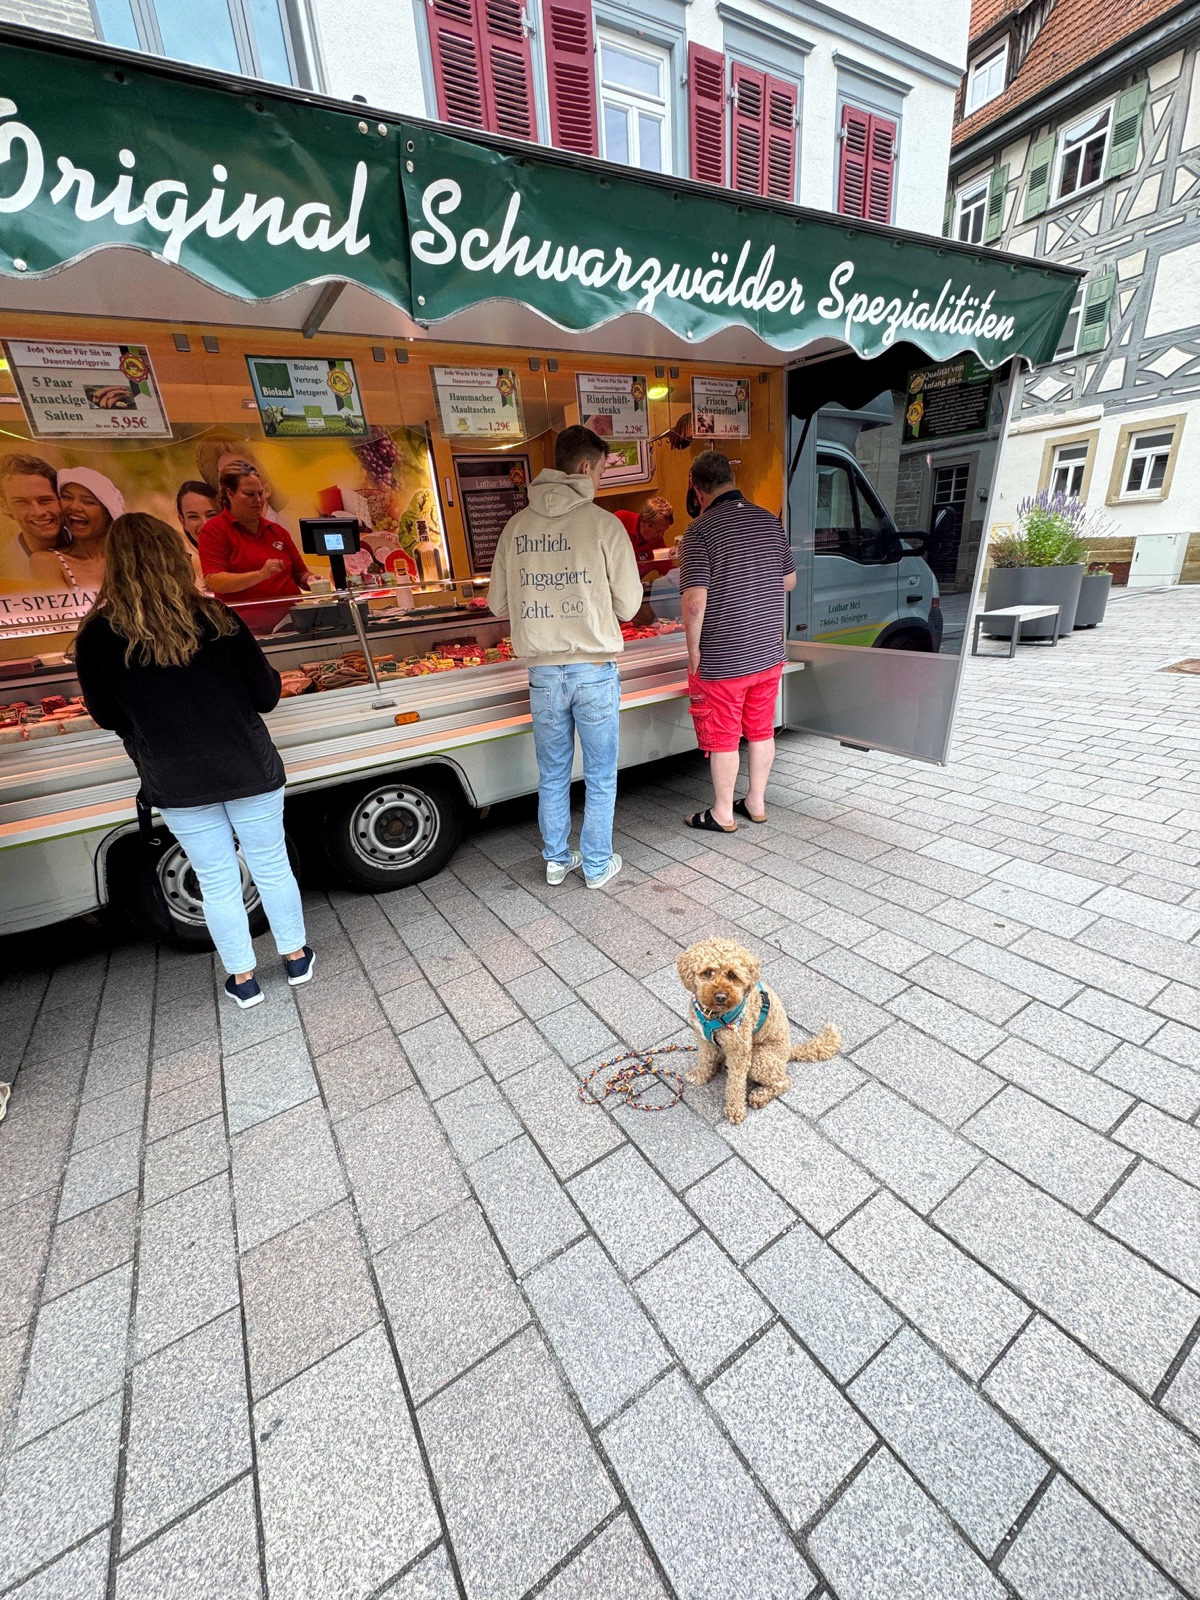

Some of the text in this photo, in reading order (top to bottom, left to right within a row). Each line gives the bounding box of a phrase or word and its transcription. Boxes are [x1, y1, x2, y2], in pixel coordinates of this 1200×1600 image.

[411, 178, 805, 314] Schwarzwälder
[817, 261, 1014, 346] Spezialitäten
[26, 345, 112, 357] Jede Woche Für Sie im
[42, 356, 110, 368] Dauerniedrigpreis
[293, 363, 319, 371] Bioland
[923, 366, 950, 381] Qualität
[951, 363, 965, 372] von
[32, 376, 73, 388] 5 Paar
[293, 376, 324, 385] Vertrags-
[922, 379, 946, 391] Anfang
[262, 386, 293, 397] Bioland
[295, 389, 328, 398] Metzgerei
[449, 392, 494, 402] Hausmacher
[30, 393, 87, 408] knackige
[586, 394, 631, 405] Rinderhüft-
[705, 396, 729, 406] Frische
[44, 409, 84, 421] Saiten
[451, 405, 496, 414] Maultaschen
[598, 405, 621, 415] steaks
[697, 405, 737, 416] Schweinefilet
[110, 416, 149, 431] 5,95€
[488, 421, 511, 432] 1,29€
[724, 424, 741, 434] 1,69€
[624, 425, 643, 436] 2,29€
[475, 479, 498, 489] Lothar
[514, 533, 571, 555] Ehrlich.
[519, 566, 592, 592] Engagiert.
[521, 600, 554, 619] Echt.
[828, 600, 861, 613] Lothar Mei
[820, 613, 868, 627] 78662 Bösingen
